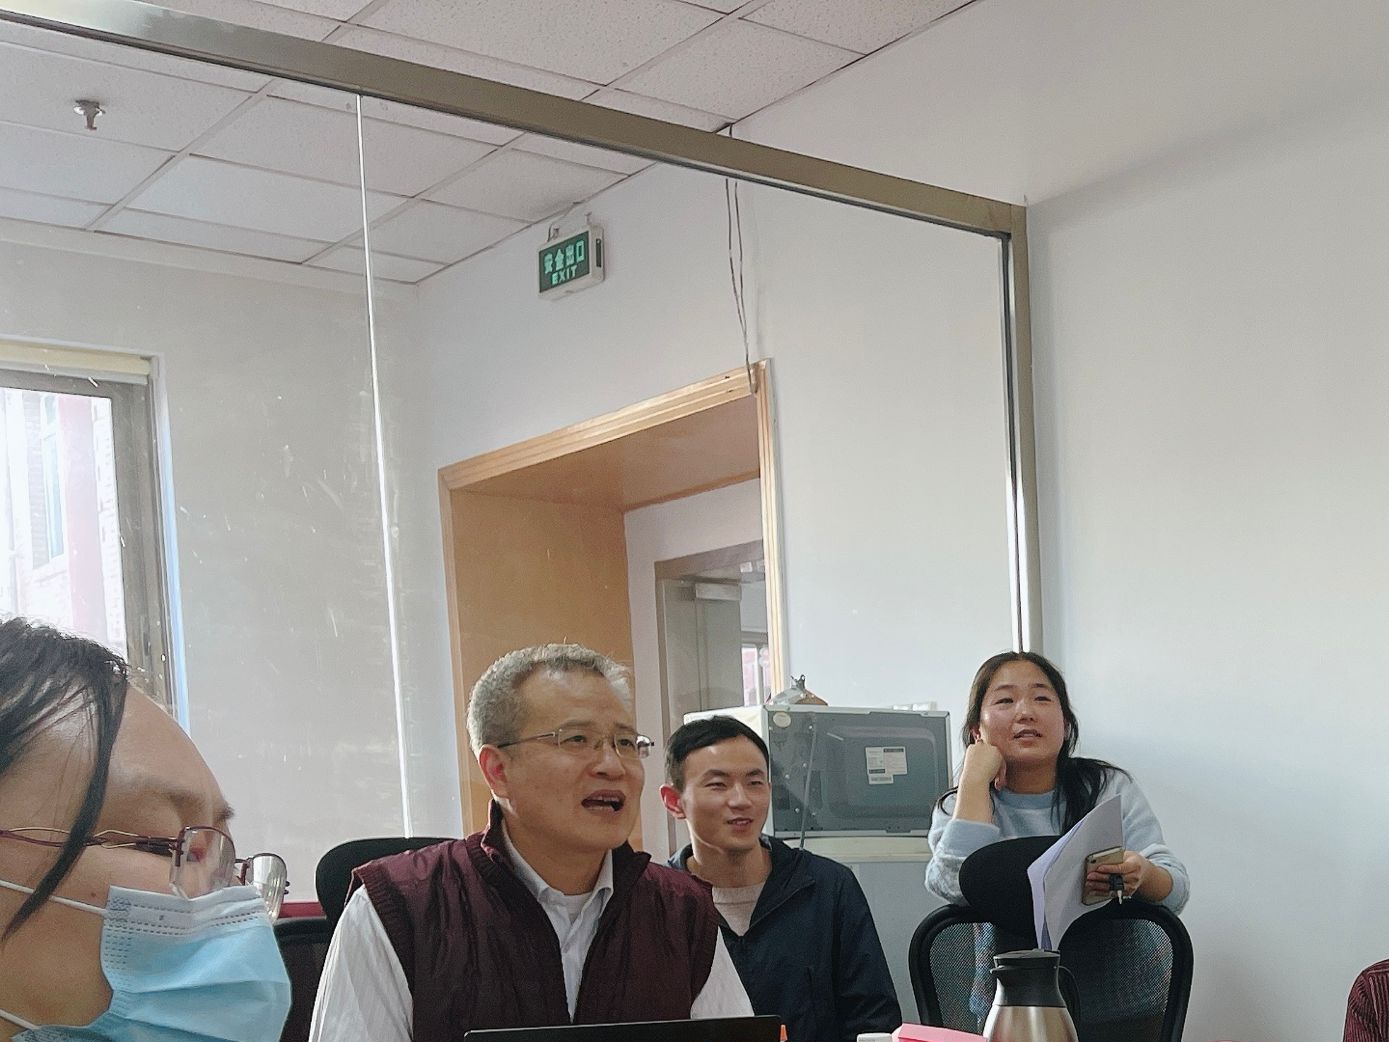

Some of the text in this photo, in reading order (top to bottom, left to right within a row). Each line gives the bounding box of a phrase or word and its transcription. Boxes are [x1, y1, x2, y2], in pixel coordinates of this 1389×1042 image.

[544, 240, 584, 274] 安全出口
[552, 265, 577, 285] EXIT
